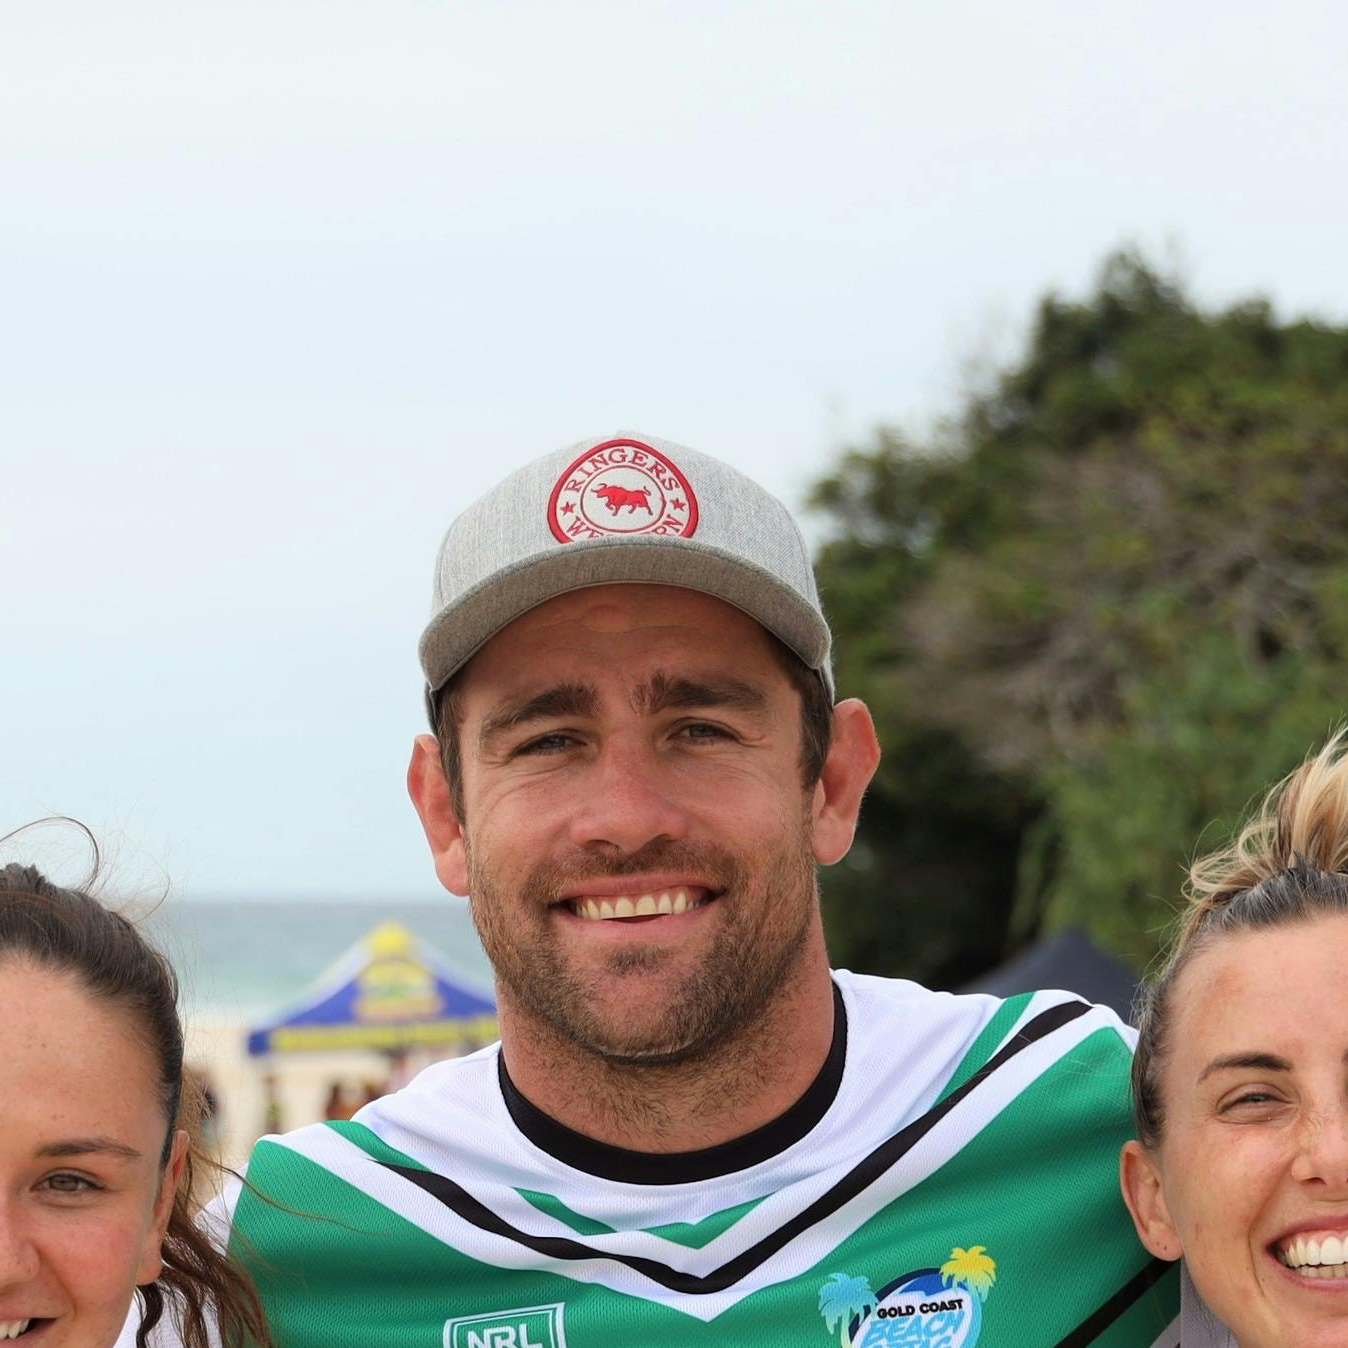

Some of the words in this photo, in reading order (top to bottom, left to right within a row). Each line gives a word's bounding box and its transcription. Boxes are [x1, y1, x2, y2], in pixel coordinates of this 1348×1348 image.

[565, 447, 680, 493] RINGERS
[877, 1305, 915, 1319] GOLD
[919, 1299, 963, 1314] COAST
